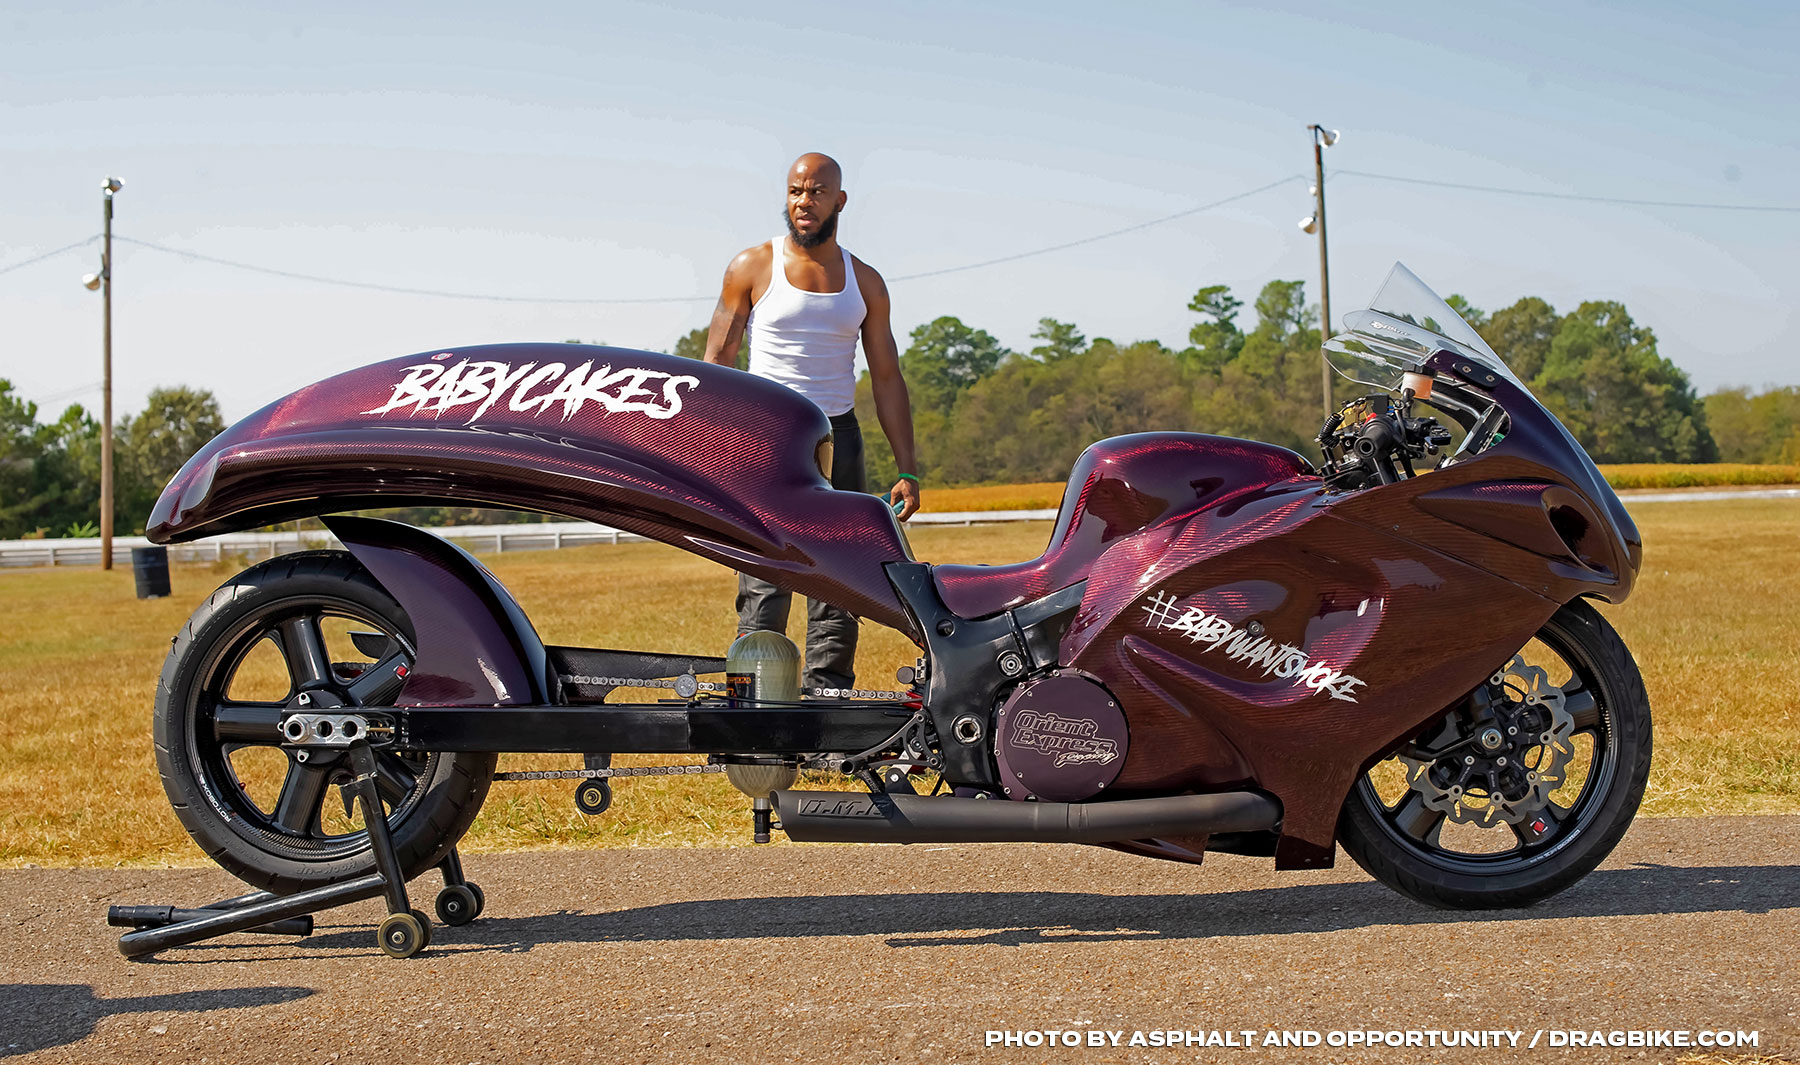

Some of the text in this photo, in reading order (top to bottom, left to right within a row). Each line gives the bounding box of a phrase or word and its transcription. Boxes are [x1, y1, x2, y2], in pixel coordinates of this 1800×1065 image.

[360, 357, 701, 426] BABYCAKES
[1141, 590, 1367, 703] #BABYWANTSMOKE
[1013, 728, 1113, 754] Express
[1016, 712, 1094, 737] Orient
[202, 783, 231, 822] ROTOBOX
